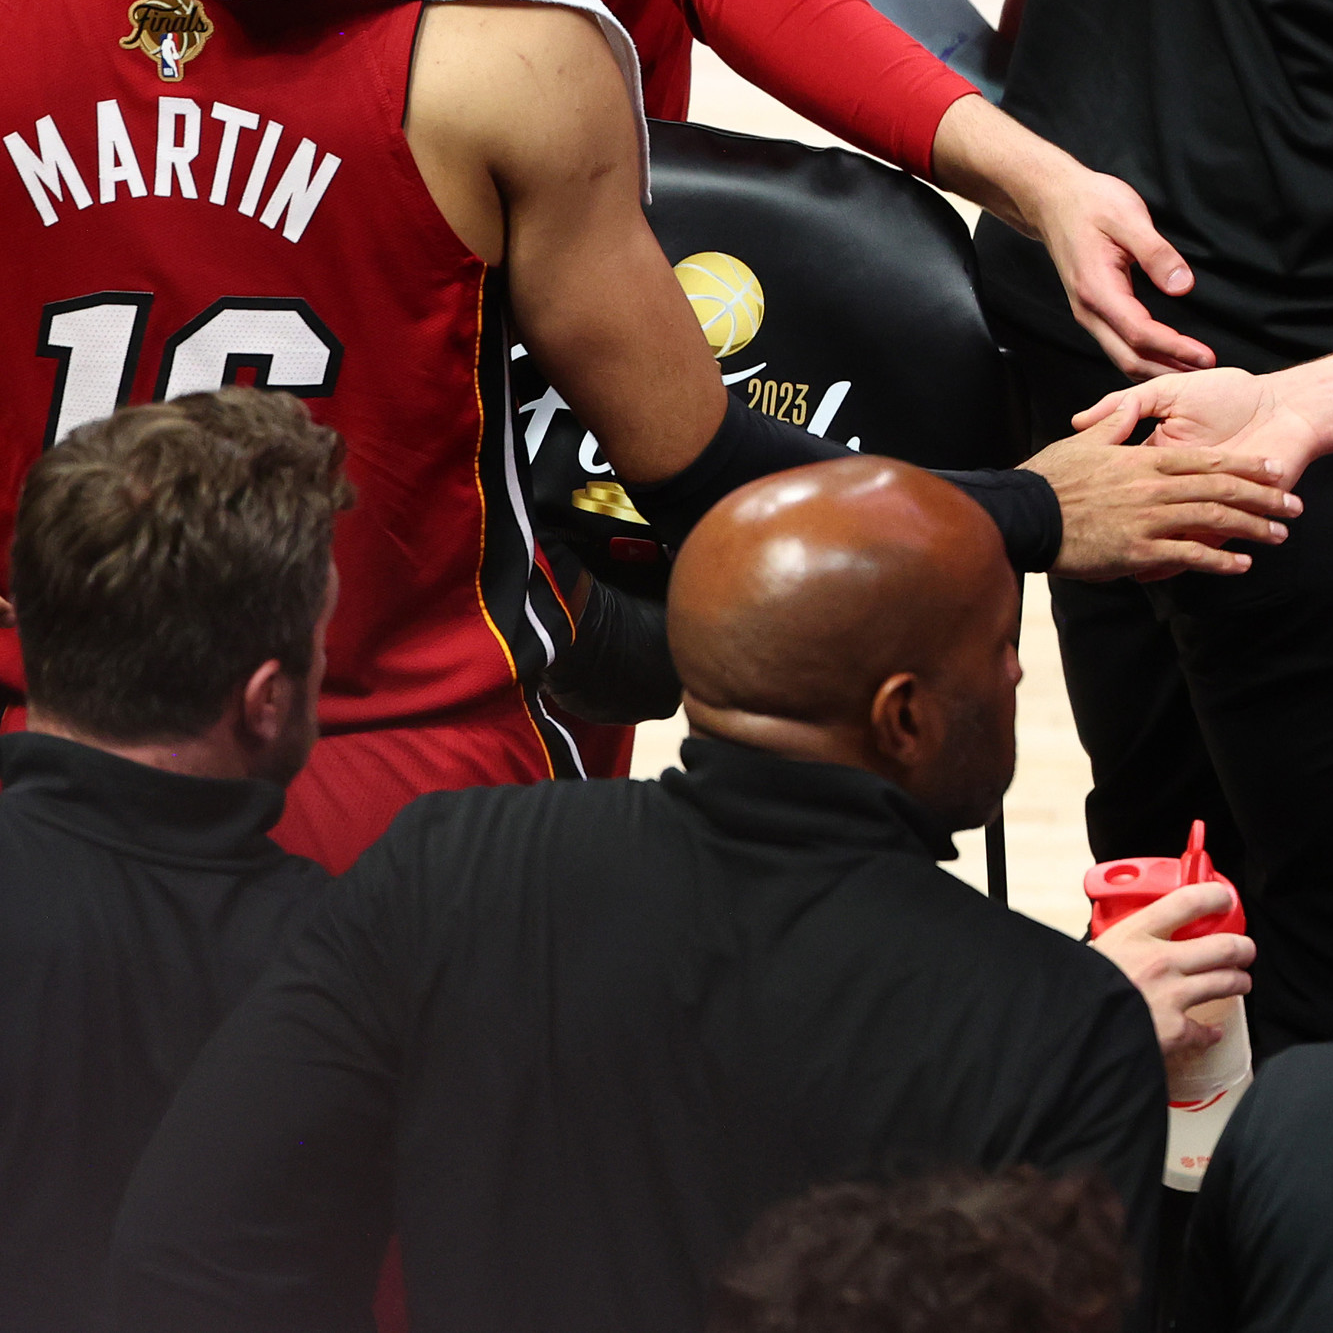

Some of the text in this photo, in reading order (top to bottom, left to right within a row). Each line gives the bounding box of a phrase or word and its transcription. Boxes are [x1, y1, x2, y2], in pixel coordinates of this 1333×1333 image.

[122, 4, 208, 45] Finals
[1, 97, 343, 244] MARTIN
[747, 377, 810, 425] 2023
